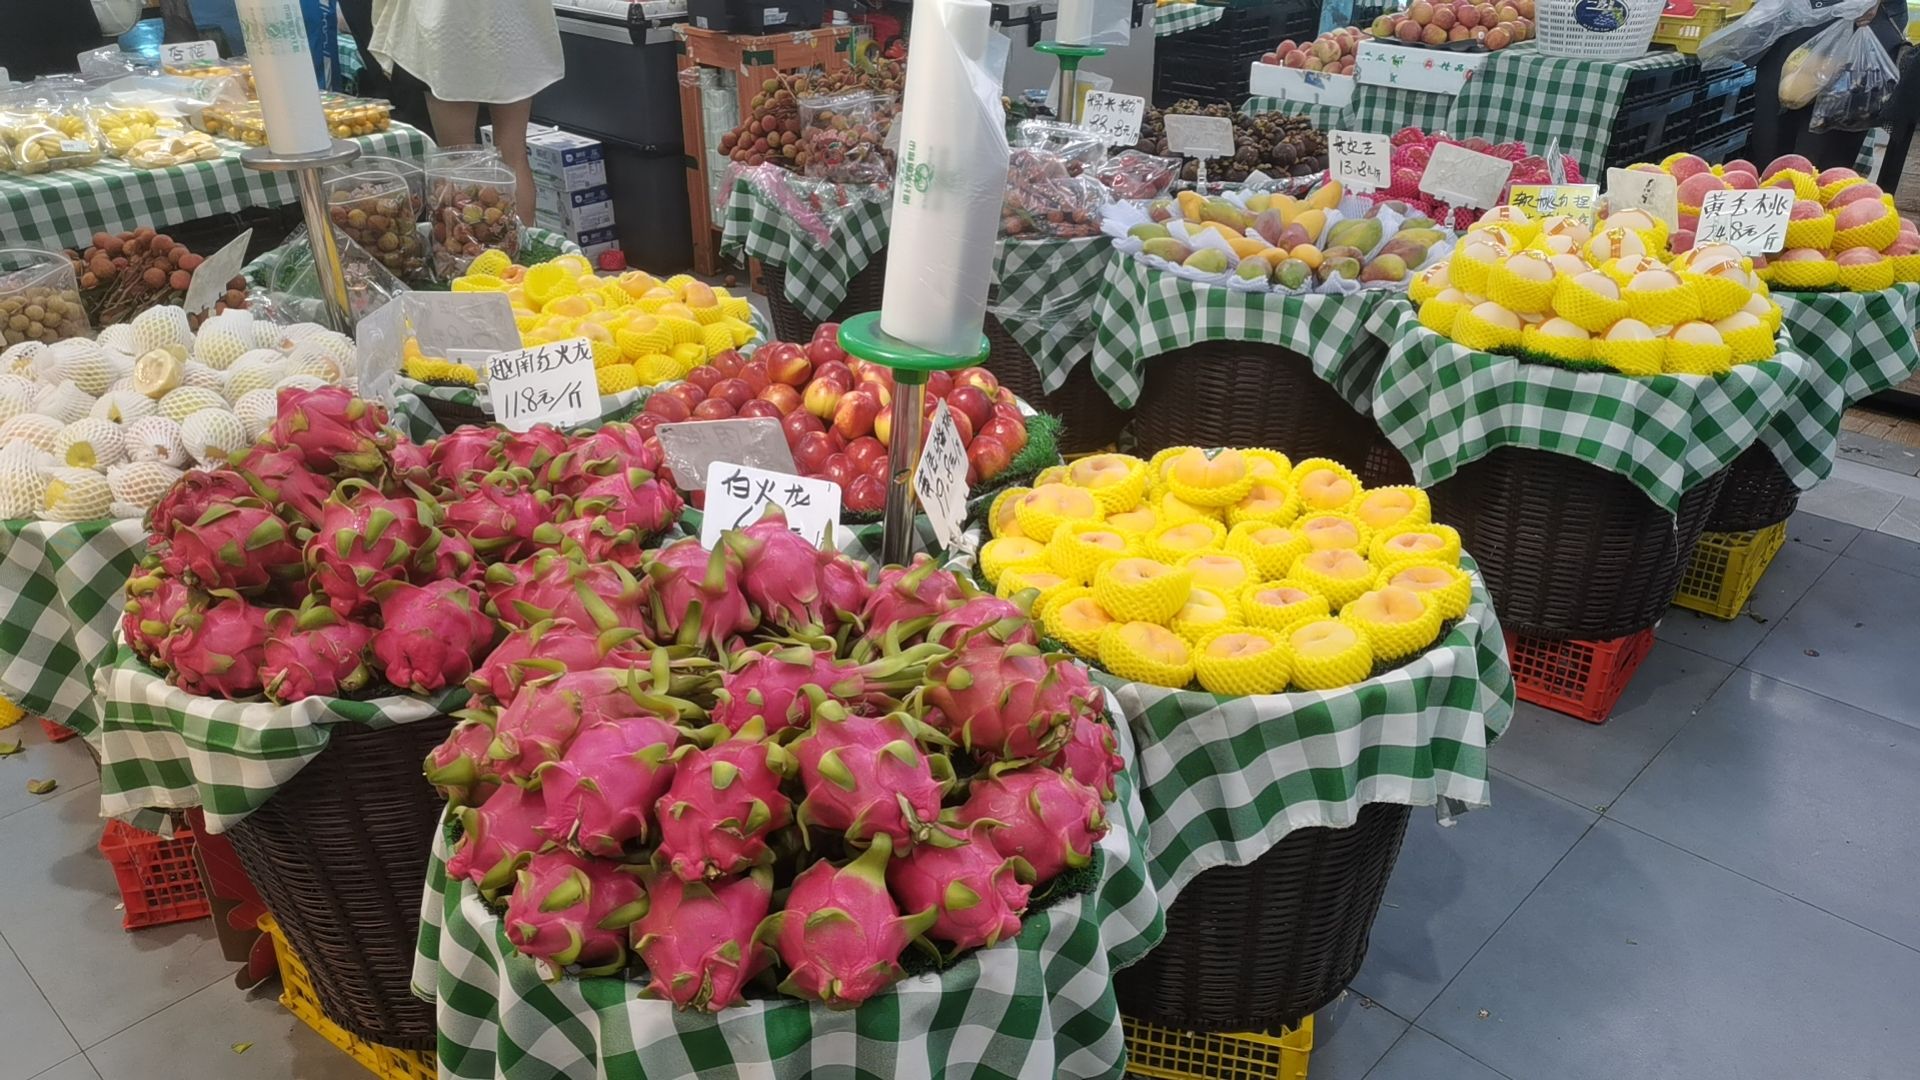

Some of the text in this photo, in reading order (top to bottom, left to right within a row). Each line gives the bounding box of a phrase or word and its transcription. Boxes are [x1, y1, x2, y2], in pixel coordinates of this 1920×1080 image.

[1703, 191, 1789, 219] 黄毛桃
[1697, 221, 1779, 250] 24.8元/斤
[488, 341, 593, 381] 越南红火龙
[504, 380, 582, 419] 11.8元/斤
[721, 468, 811, 508] 白火龙
